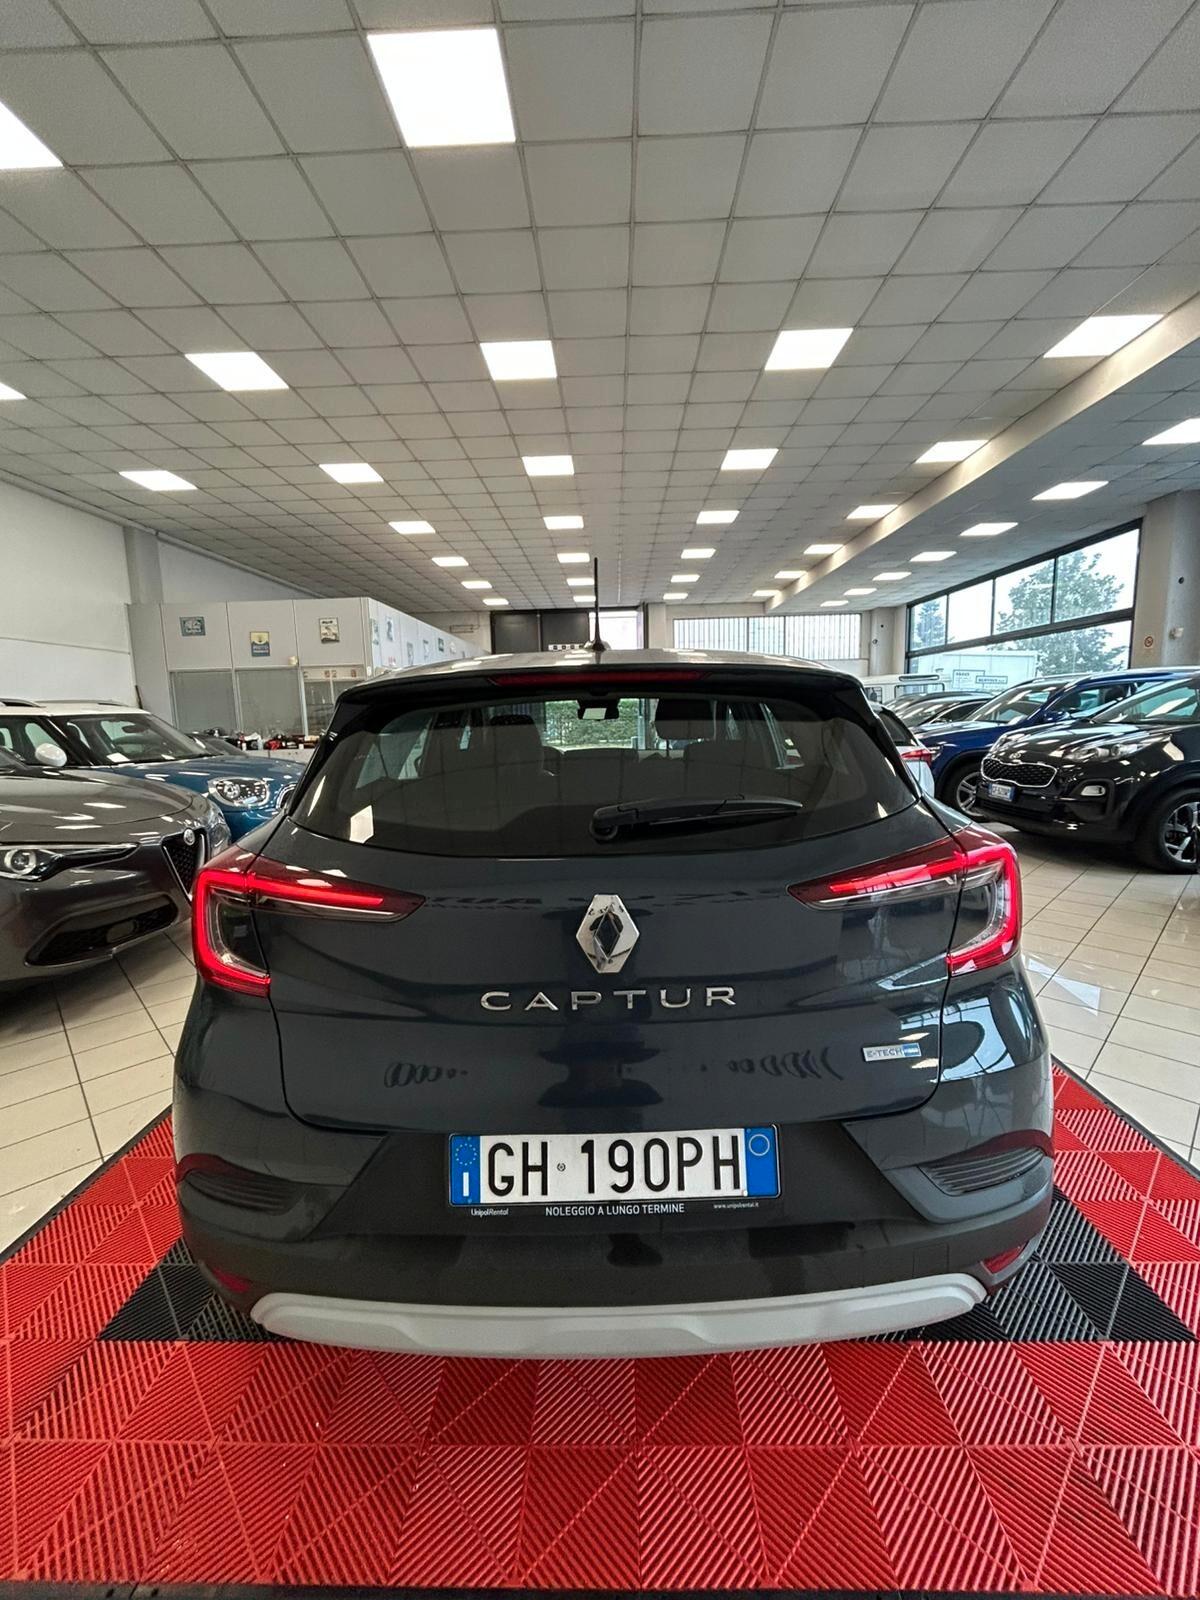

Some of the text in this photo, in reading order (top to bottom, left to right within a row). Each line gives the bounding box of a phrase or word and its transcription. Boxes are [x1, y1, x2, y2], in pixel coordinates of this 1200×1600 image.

[480, 986, 737, 1011] CAPTUR
[866, 1047, 903, 1058] E-TECH
[488, 1135, 741, 1197] GH 190PH
[470, 1207, 509, 1218] UnipolRental
[545, 1202, 685, 1217] NOLEGGIO A LUNGO TERMINE
